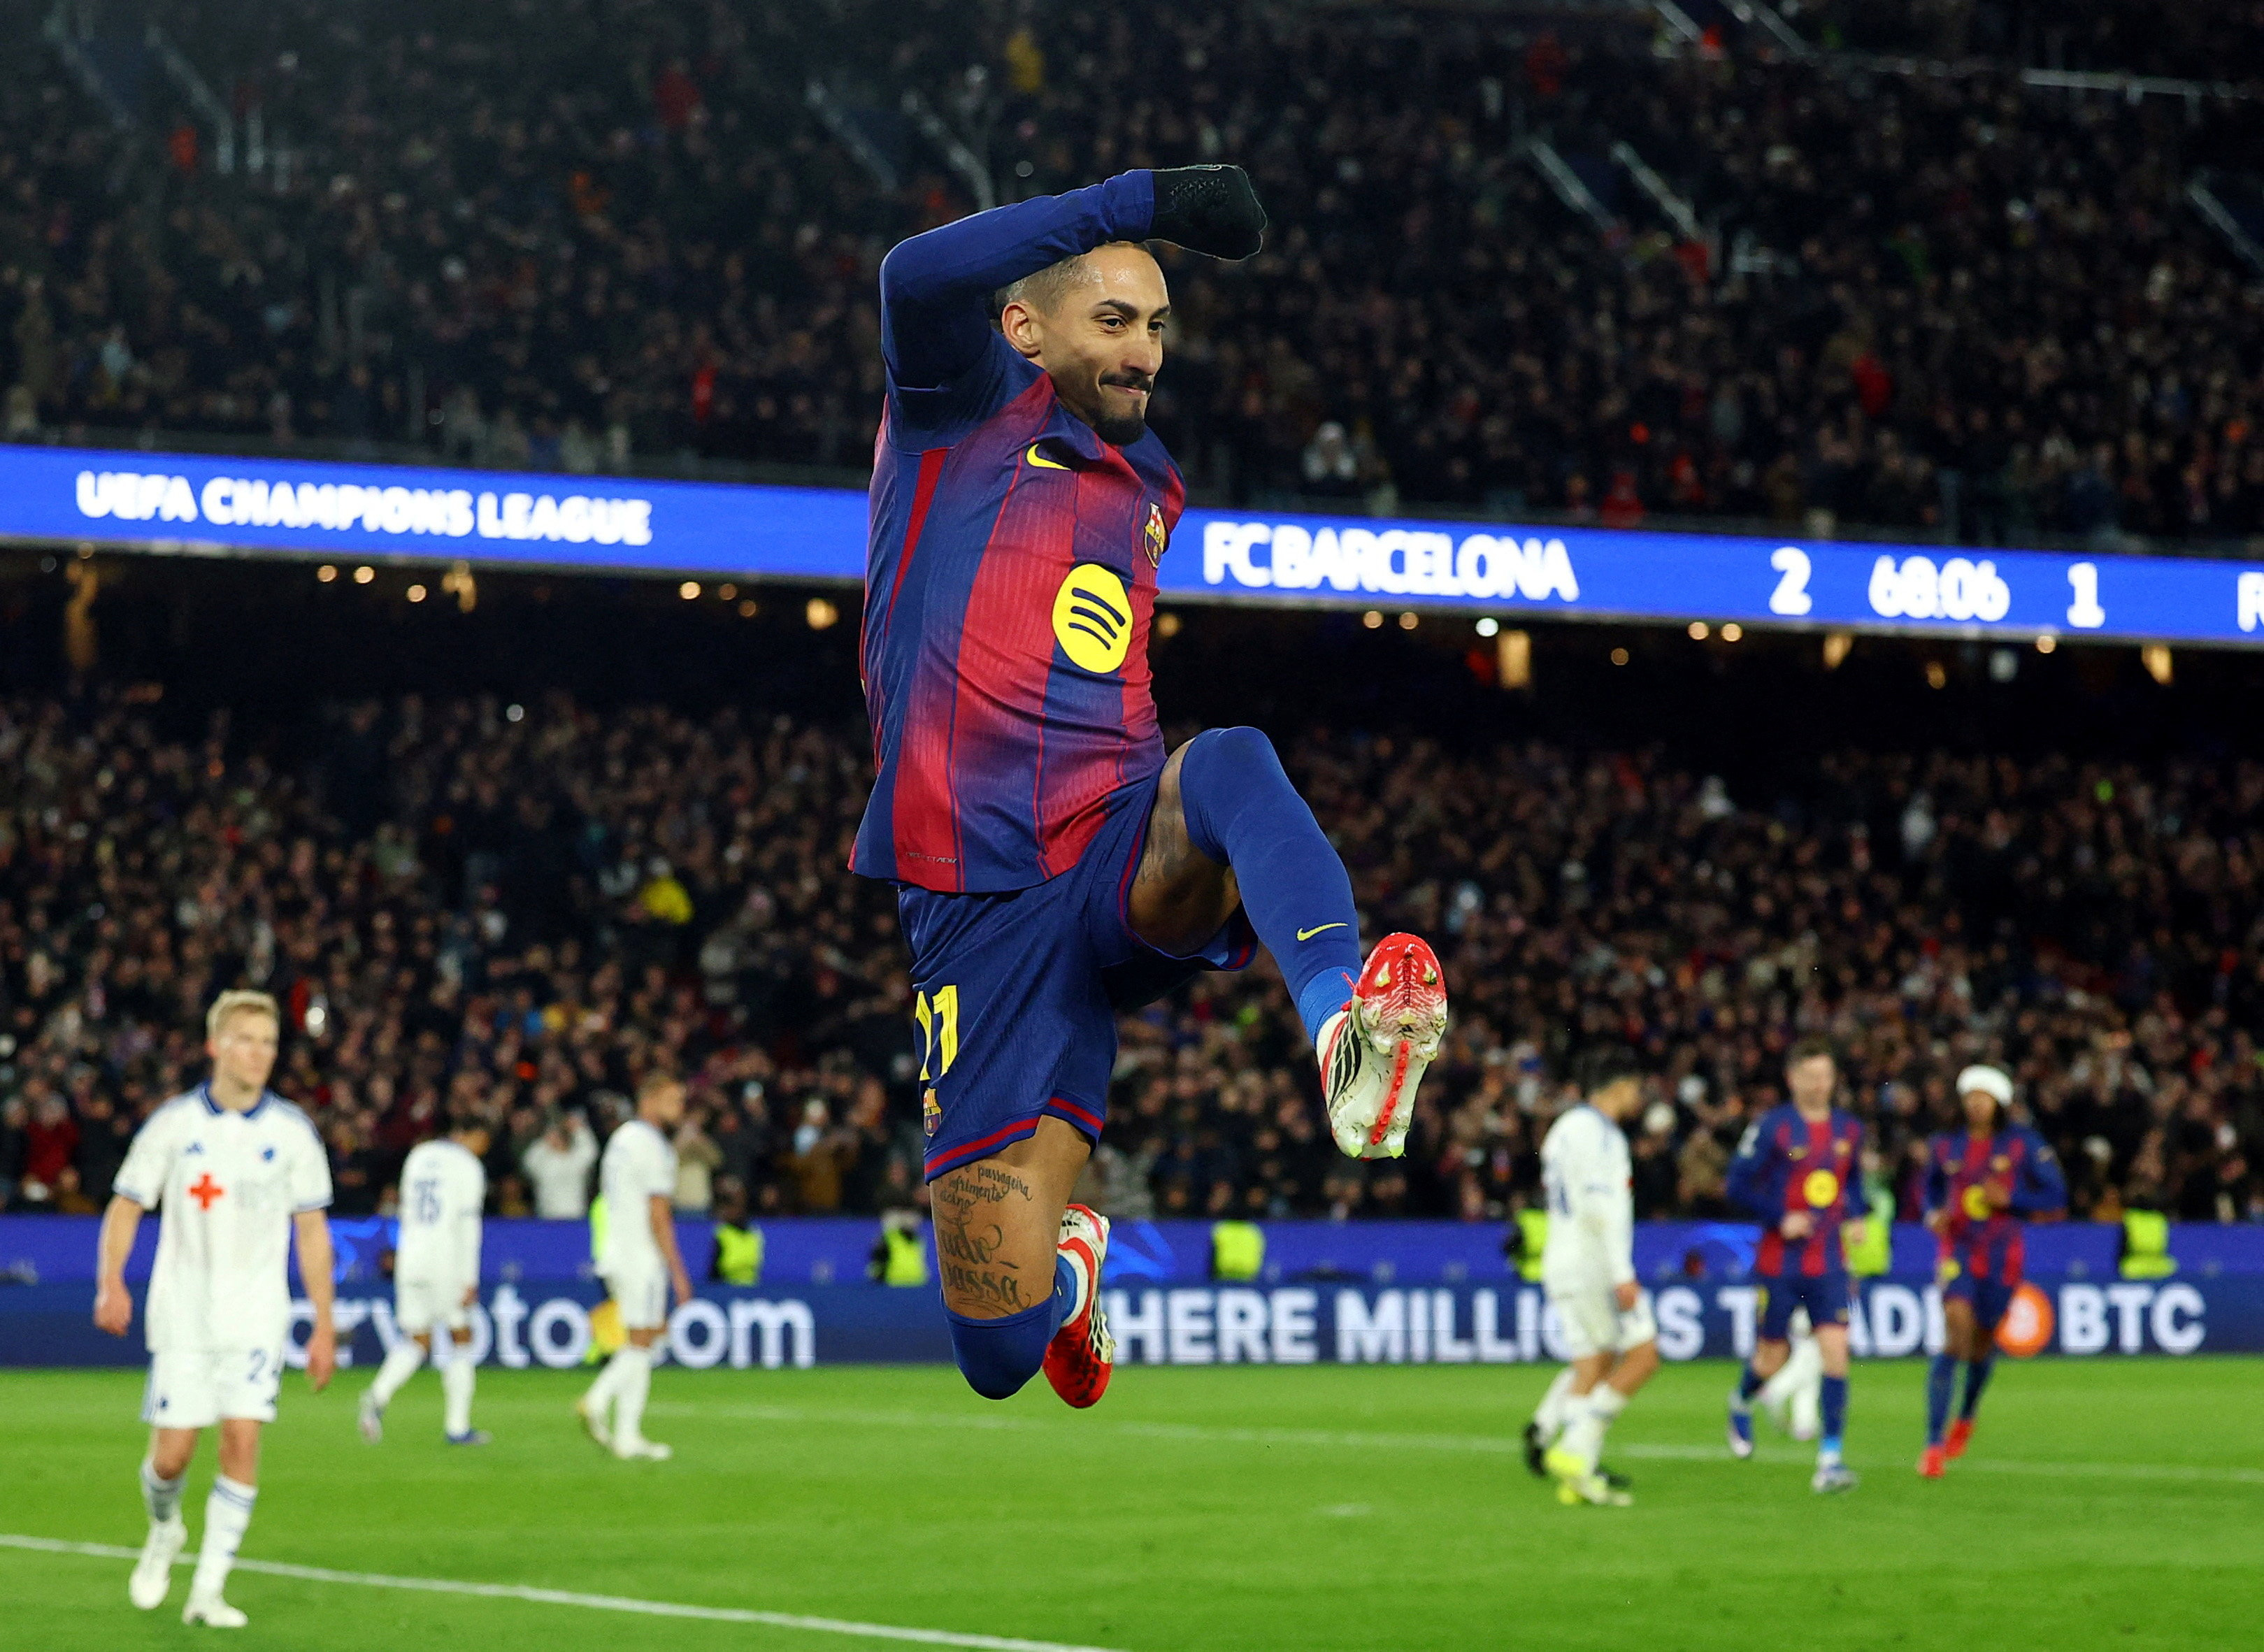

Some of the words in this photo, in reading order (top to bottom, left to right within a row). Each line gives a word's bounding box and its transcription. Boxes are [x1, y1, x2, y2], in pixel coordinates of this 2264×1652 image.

[75, 470, 198, 522] UEFA
[200, 477, 475, 537] CHAMPIONS
[477, 491, 653, 546] LEAGUE
[1768, 546, 1812, 616] 2
[2066, 561, 2105, 629] 1
[1101, 1288, 1318, 1365] HERE
[1335, 1286, 1704, 1363] MILLIS
[2058, 1284, 2205, 1355] BTC
